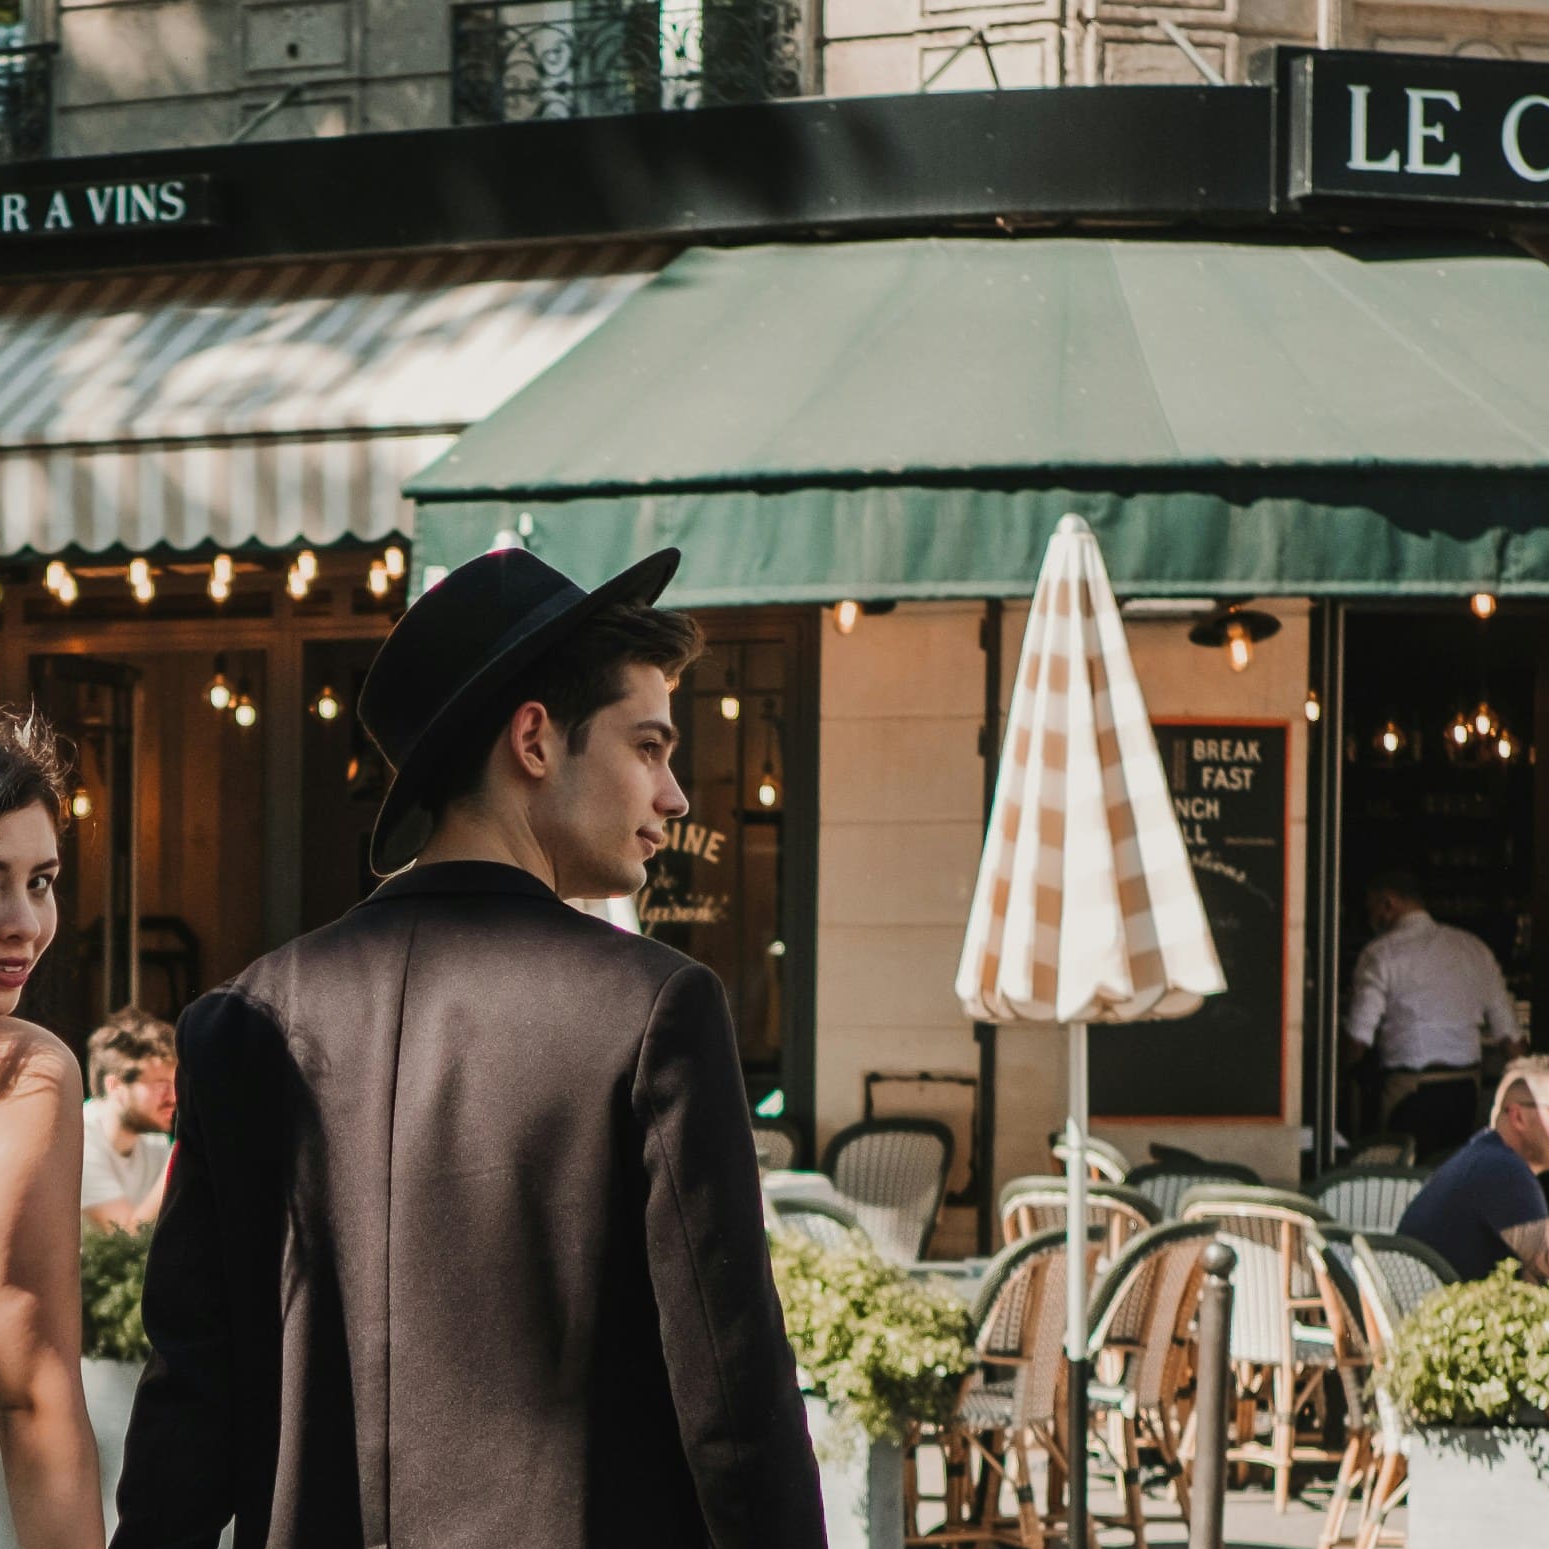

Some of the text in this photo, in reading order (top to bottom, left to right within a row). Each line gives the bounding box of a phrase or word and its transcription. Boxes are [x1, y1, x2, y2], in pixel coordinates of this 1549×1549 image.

[1347, 85, 1461, 176] LE
[44, 191, 73, 229] A
[86, 181, 185, 224] VINS
[1192, 739, 1261, 762] BREAK
[1201, 766, 1254, 790] FAST
[1175, 797, 1220, 820] NCH
